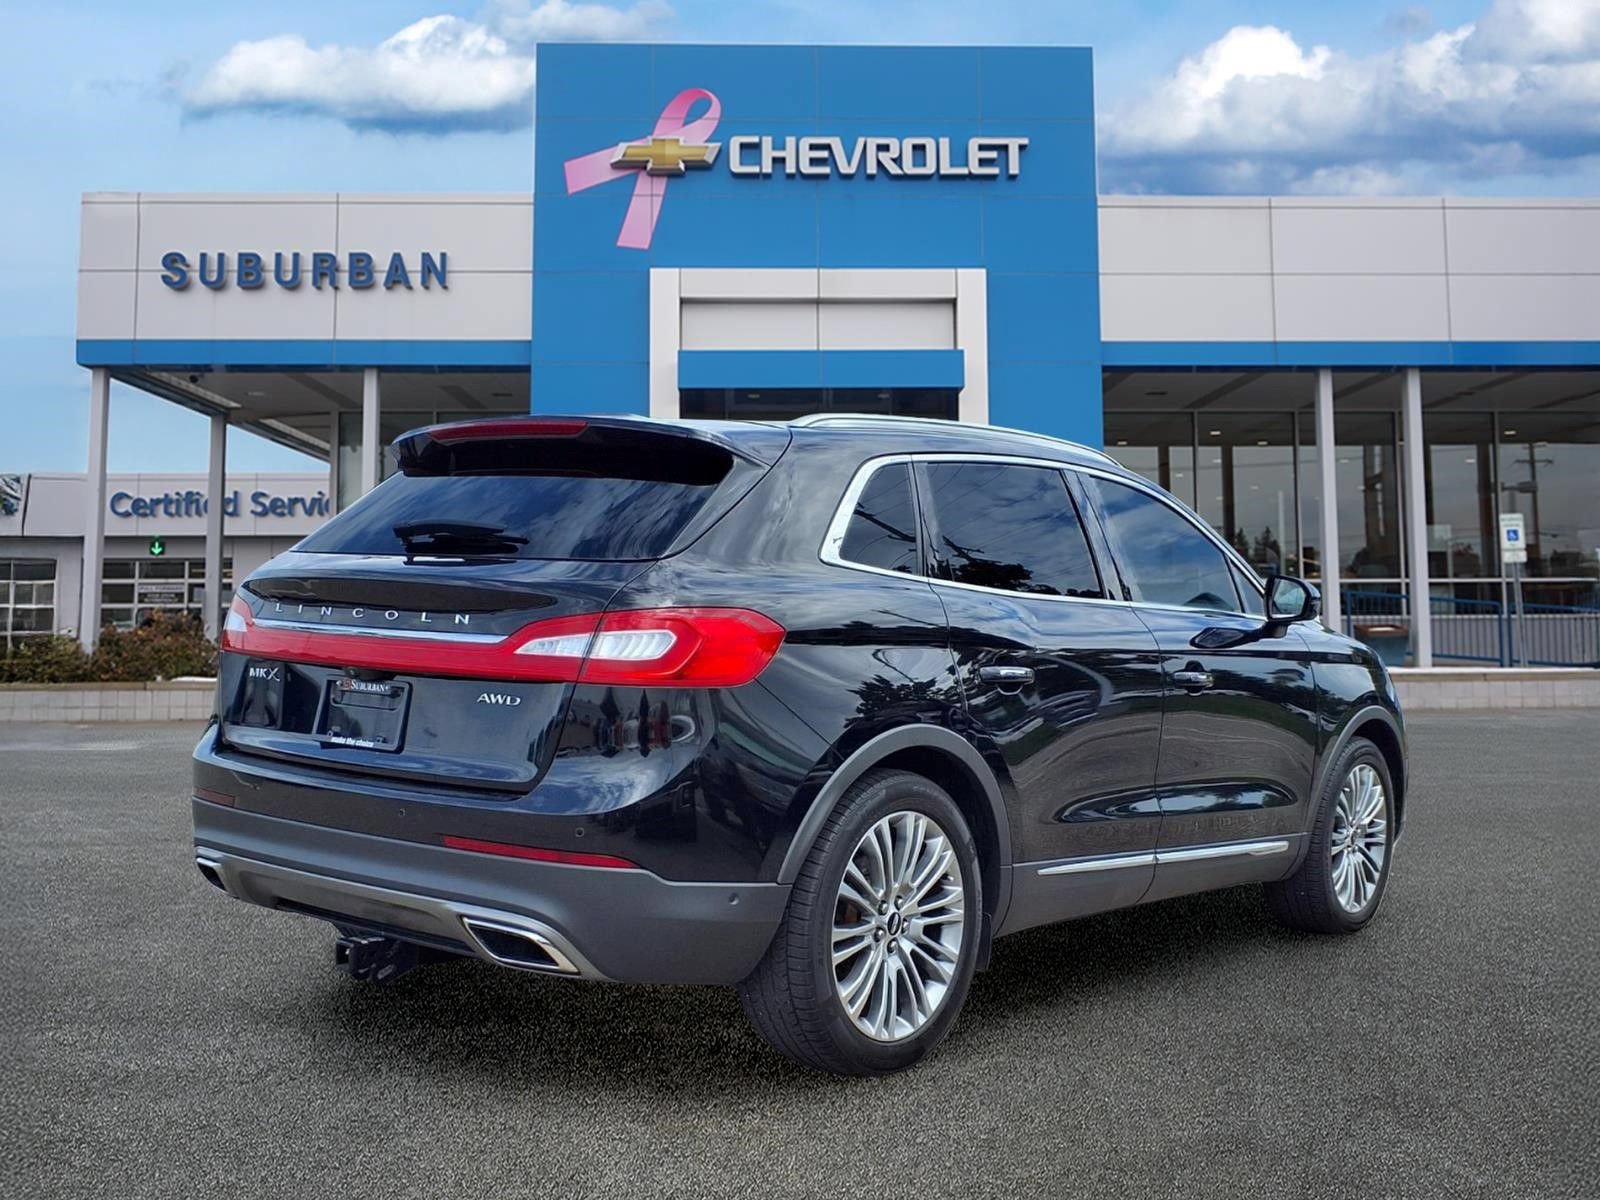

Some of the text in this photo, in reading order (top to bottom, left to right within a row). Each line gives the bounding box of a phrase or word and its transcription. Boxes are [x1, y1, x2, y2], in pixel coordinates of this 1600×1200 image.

[729, 136, 1029, 176] CHEVROLET
[161, 252, 449, 290] SUBURBAN
[110, 491, 240, 518] Certifid
[274, 602, 470, 625] LINCOLN
[249, 666, 281, 682] MKX
[477, 692, 521, 706] AWD
